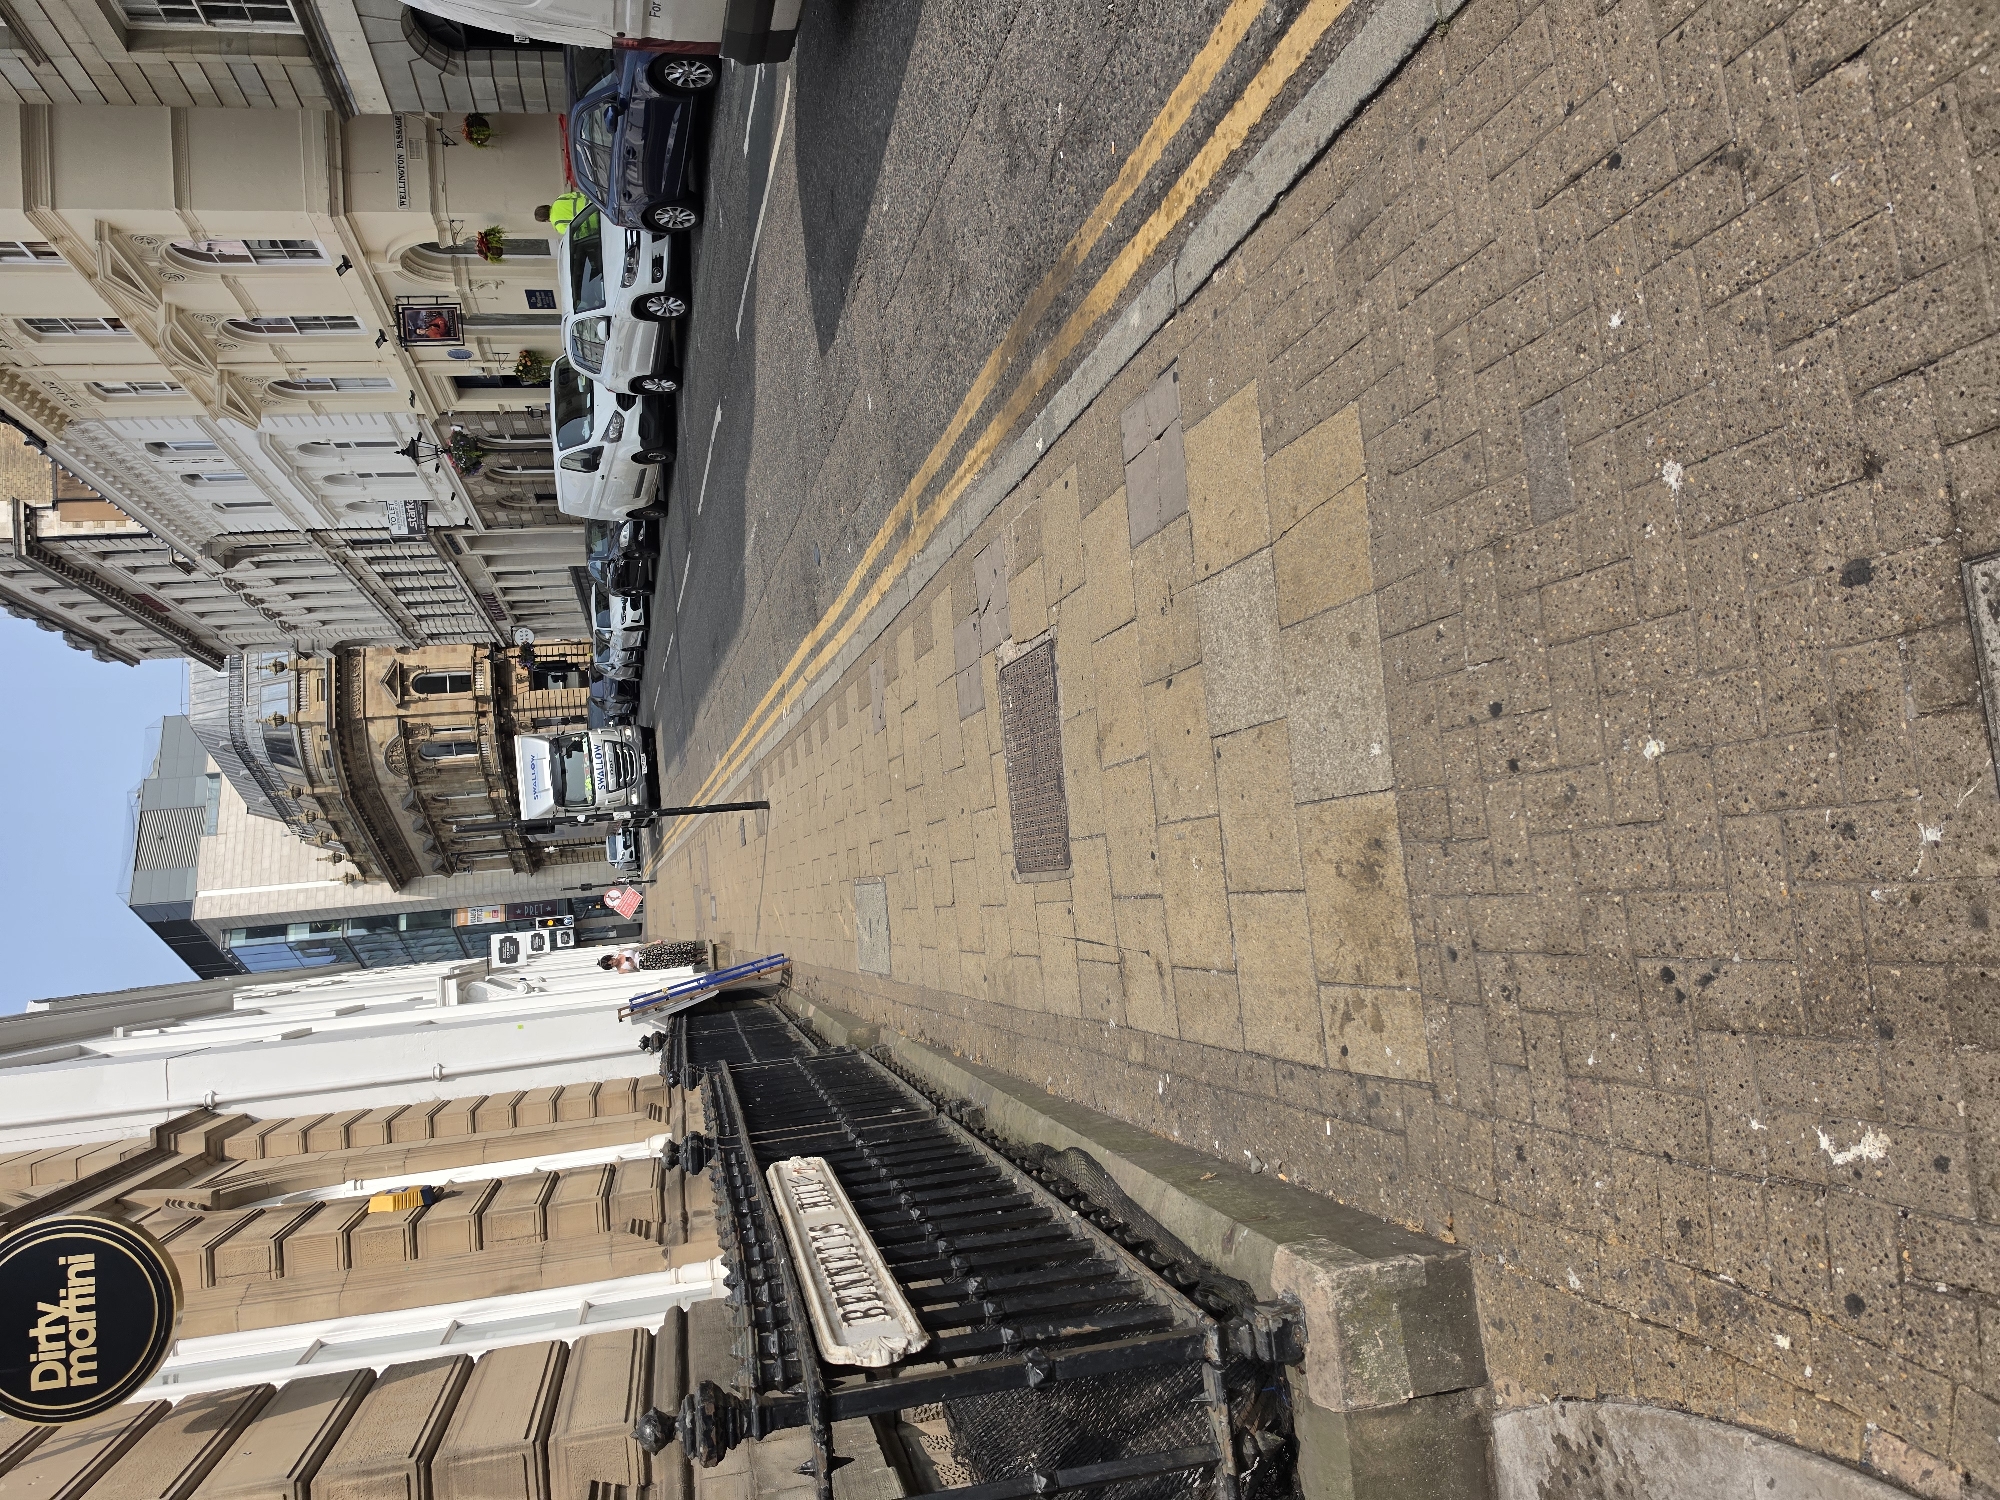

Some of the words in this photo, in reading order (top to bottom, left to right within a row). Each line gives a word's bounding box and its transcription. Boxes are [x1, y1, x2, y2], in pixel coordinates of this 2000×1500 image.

[395, 115, 404, 149] PASSAGE
[397, 154, 407, 206] WELLINGTON
[390, 517, 396, 526] TO
[530, 754, 539, 800] SWALLOW
[593, 744, 606, 790] SWALLOW
[524, 904, 543, 916] PRET
[790, 1180, 835, 1214] HILL
[807, 1223, 890, 1328] BENNETTS
[59, 1253, 97, 1386] martini
[29, 1302, 71, 1391] Dirty
